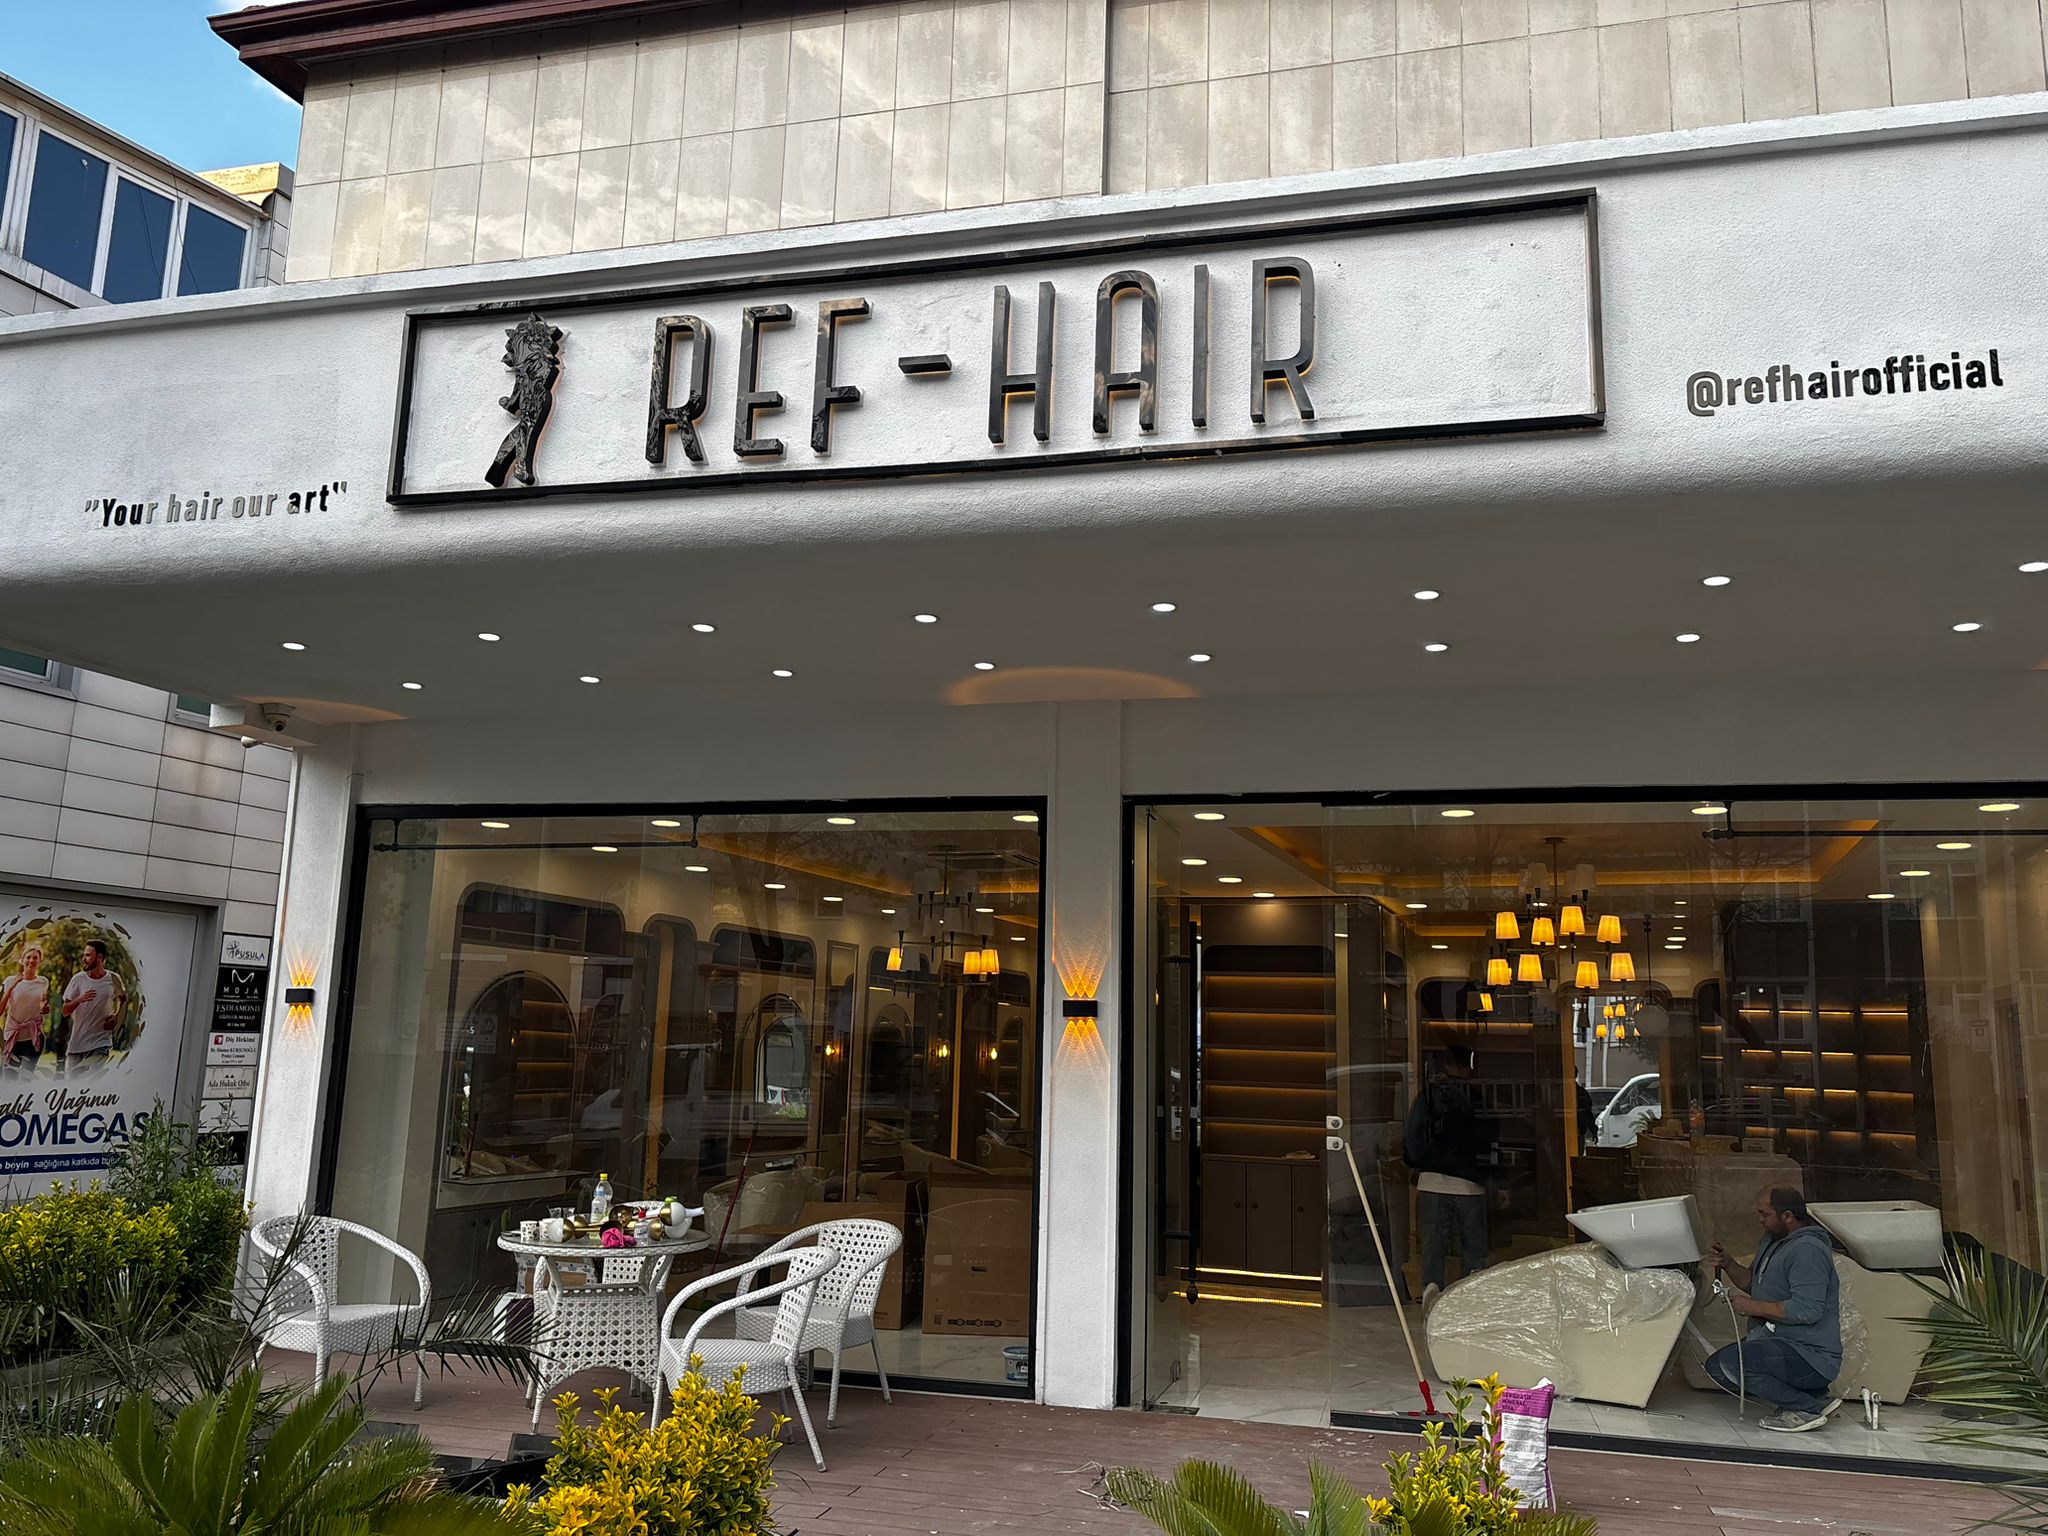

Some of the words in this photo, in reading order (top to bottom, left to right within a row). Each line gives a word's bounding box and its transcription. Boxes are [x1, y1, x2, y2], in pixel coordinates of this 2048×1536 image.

[1686, 349, 2003, 417] @refhairofficial
[166, 492, 223, 523] hair
[231, 493, 278, 518] our
[234, 949, 265, 960] PUSULA
[45, 1088, 120, 1118] Yağının
[5, 1161, 29, 1171] beyin
